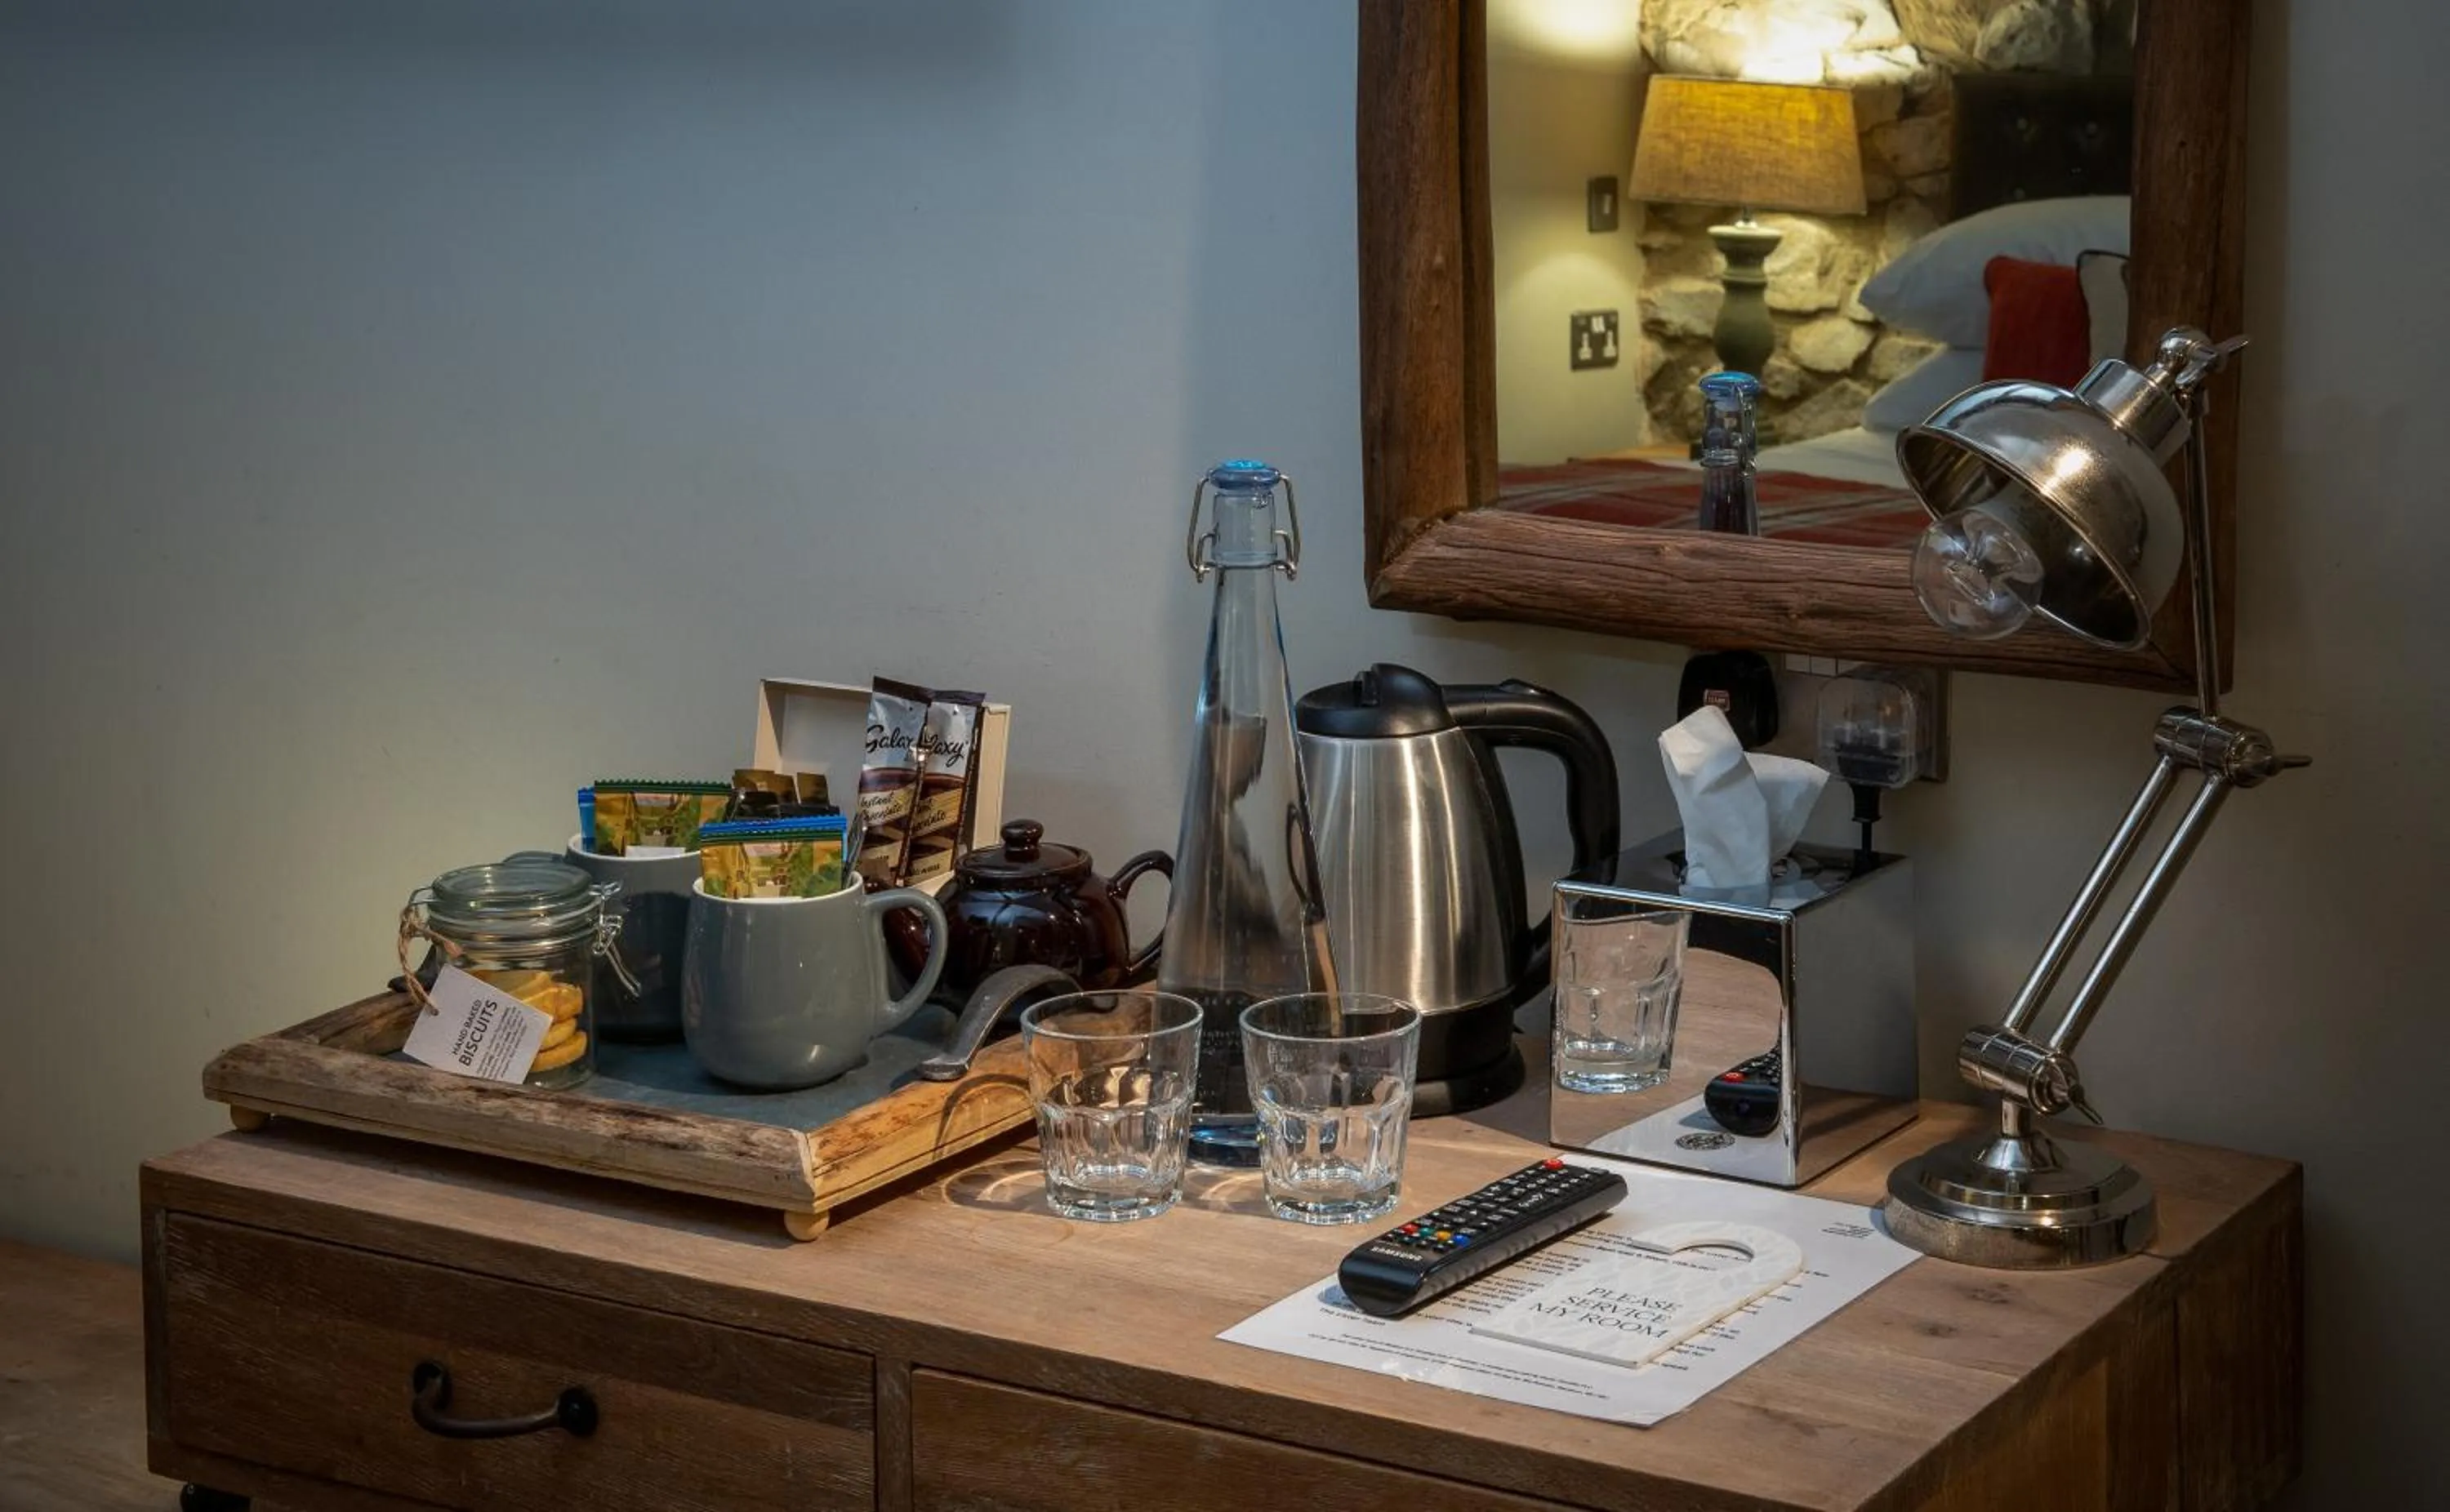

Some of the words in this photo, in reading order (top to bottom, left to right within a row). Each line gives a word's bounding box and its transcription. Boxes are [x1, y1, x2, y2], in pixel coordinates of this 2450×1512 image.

[865, 724, 914, 754] Galax
[452, 1028, 469, 1056] HAND
[464, 998, 483, 1029] BAKED
[458, 998, 497, 1066] BISCUITS
[1561, 1296, 1673, 1322] SERVICE
[1587, 1287, 1682, 1311] PLEASE
[1529, 1302, 1577, 1317] MY
[1579, 1312, 1668, 1338] ROOM
